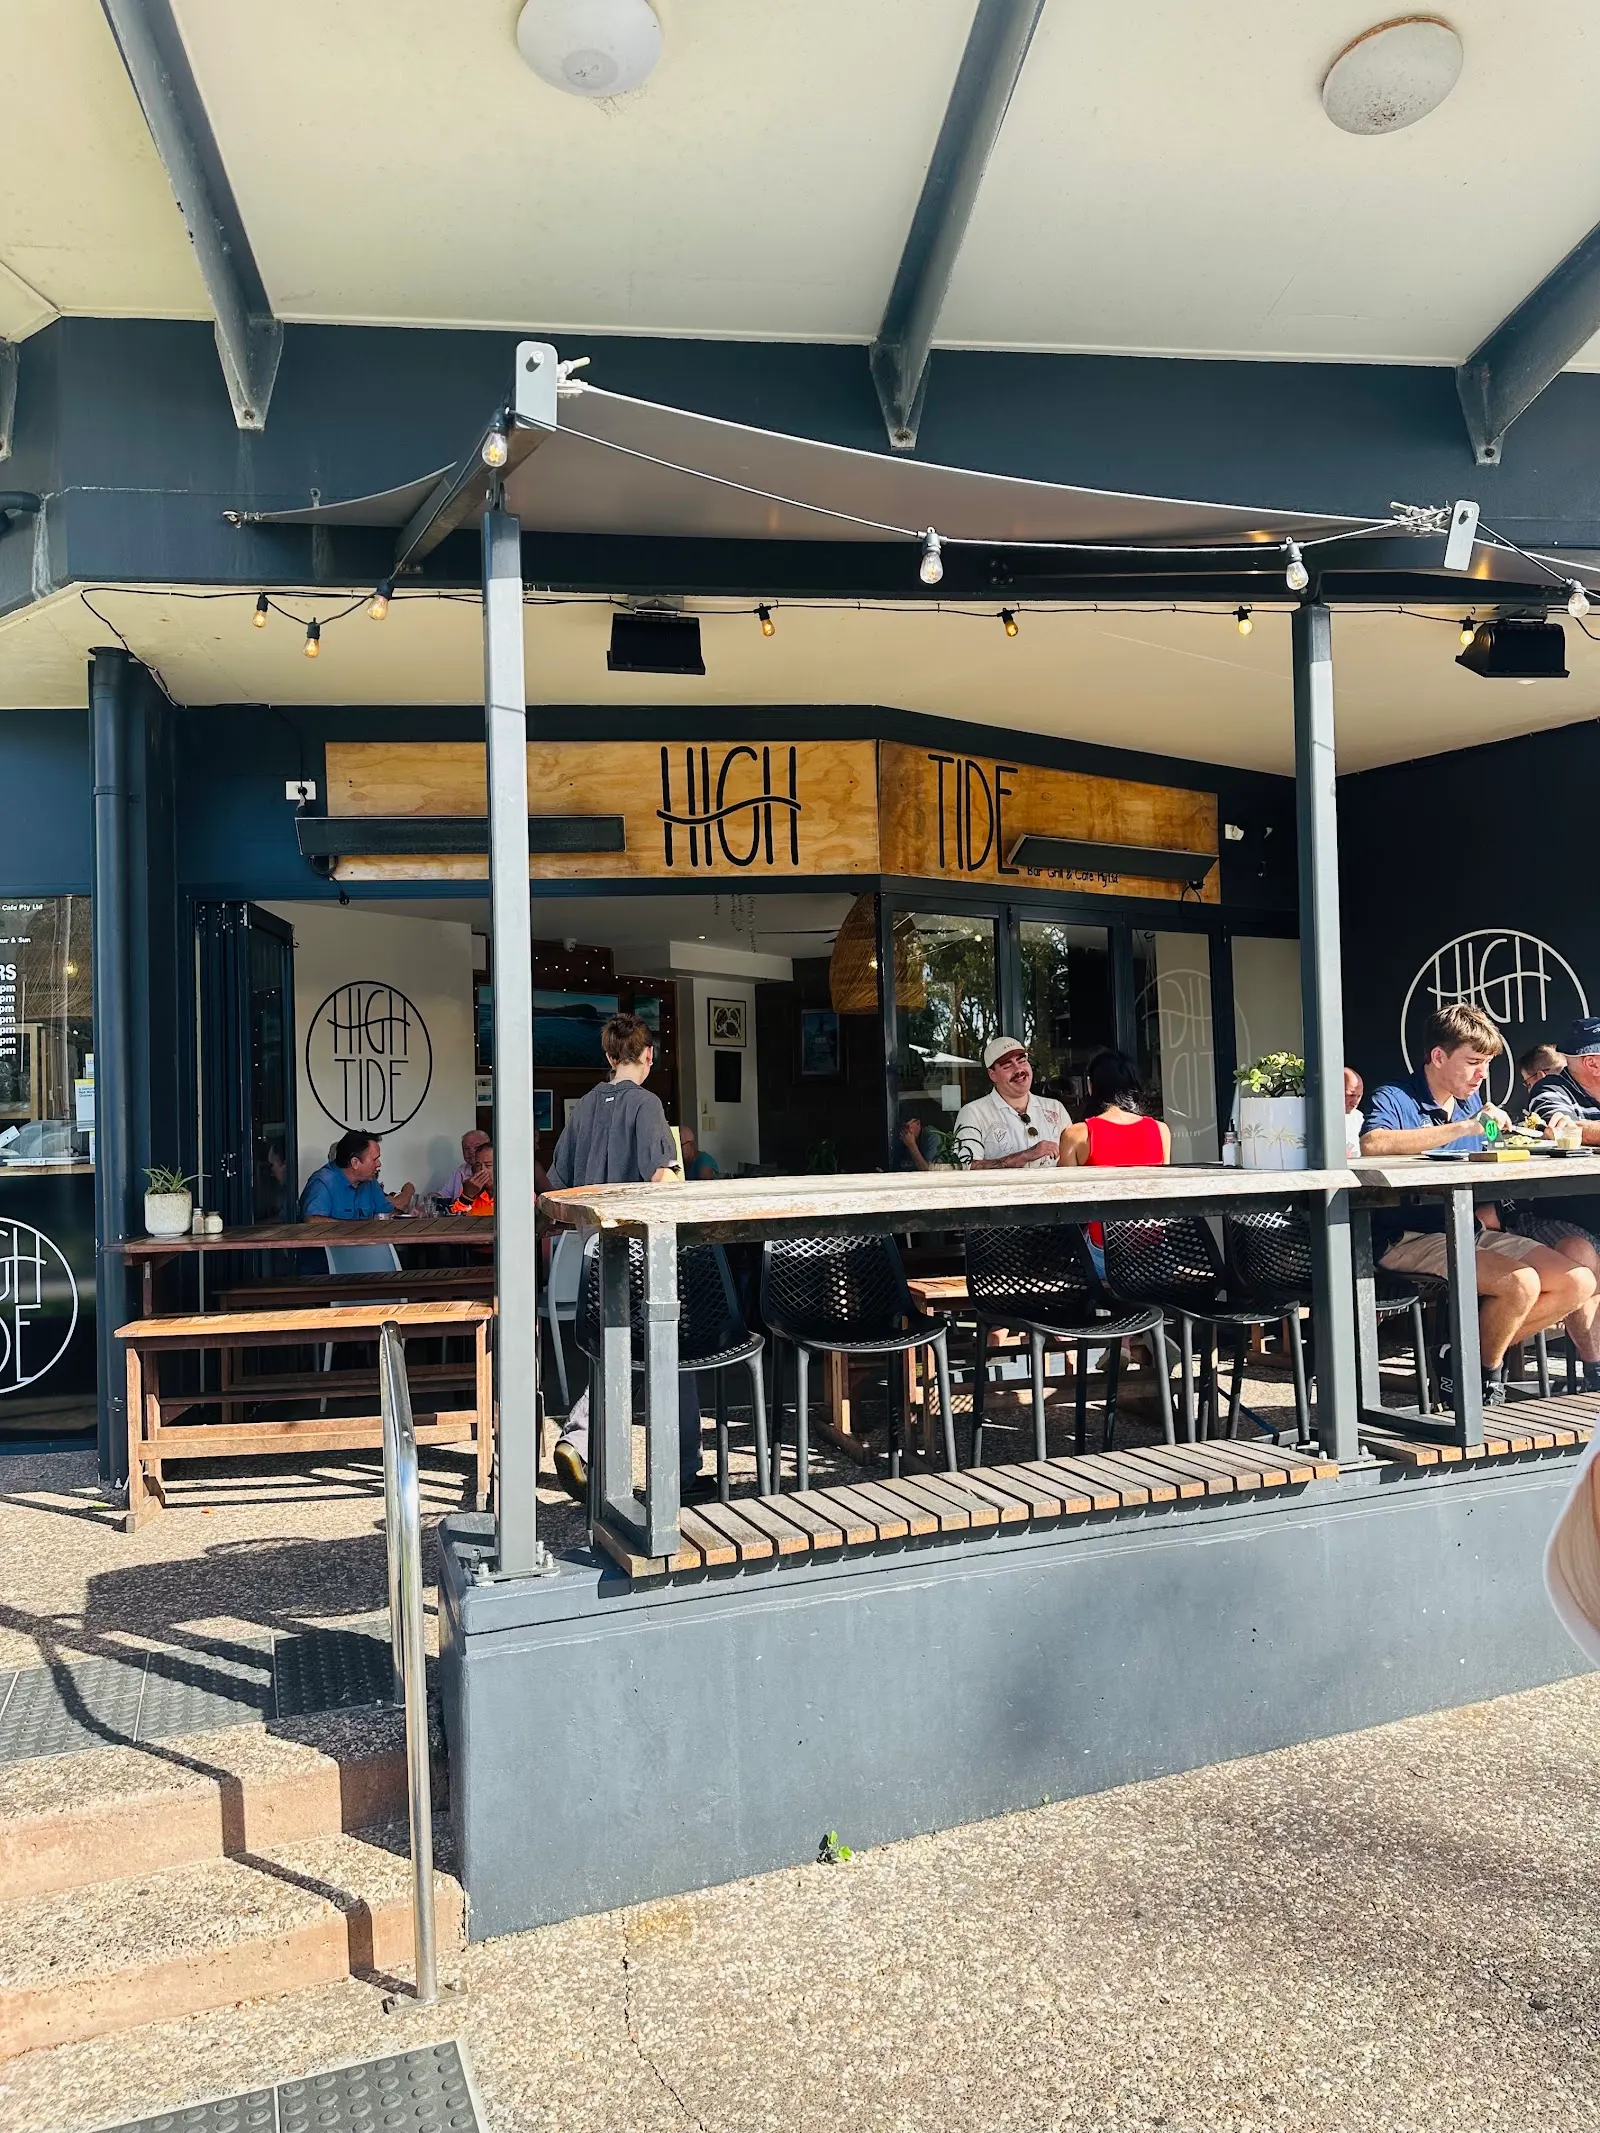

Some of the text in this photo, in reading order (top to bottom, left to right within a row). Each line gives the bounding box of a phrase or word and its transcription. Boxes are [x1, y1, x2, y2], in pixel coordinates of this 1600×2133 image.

[656, 746, 802, 867] HIGH
[927, 753, 1020, 875] TIDE
[1066, 869, 1073, 880] &
[19, 903, 31, 912] Pty
[10, 936, 17, 944] &
[1427, 934, 1552, 1023] HIGH
[327, 988, 411, 1055] HIGH
[334, 1059, 409, 1123] TIDE
[1487, 1122, 1497, 1137] 31
